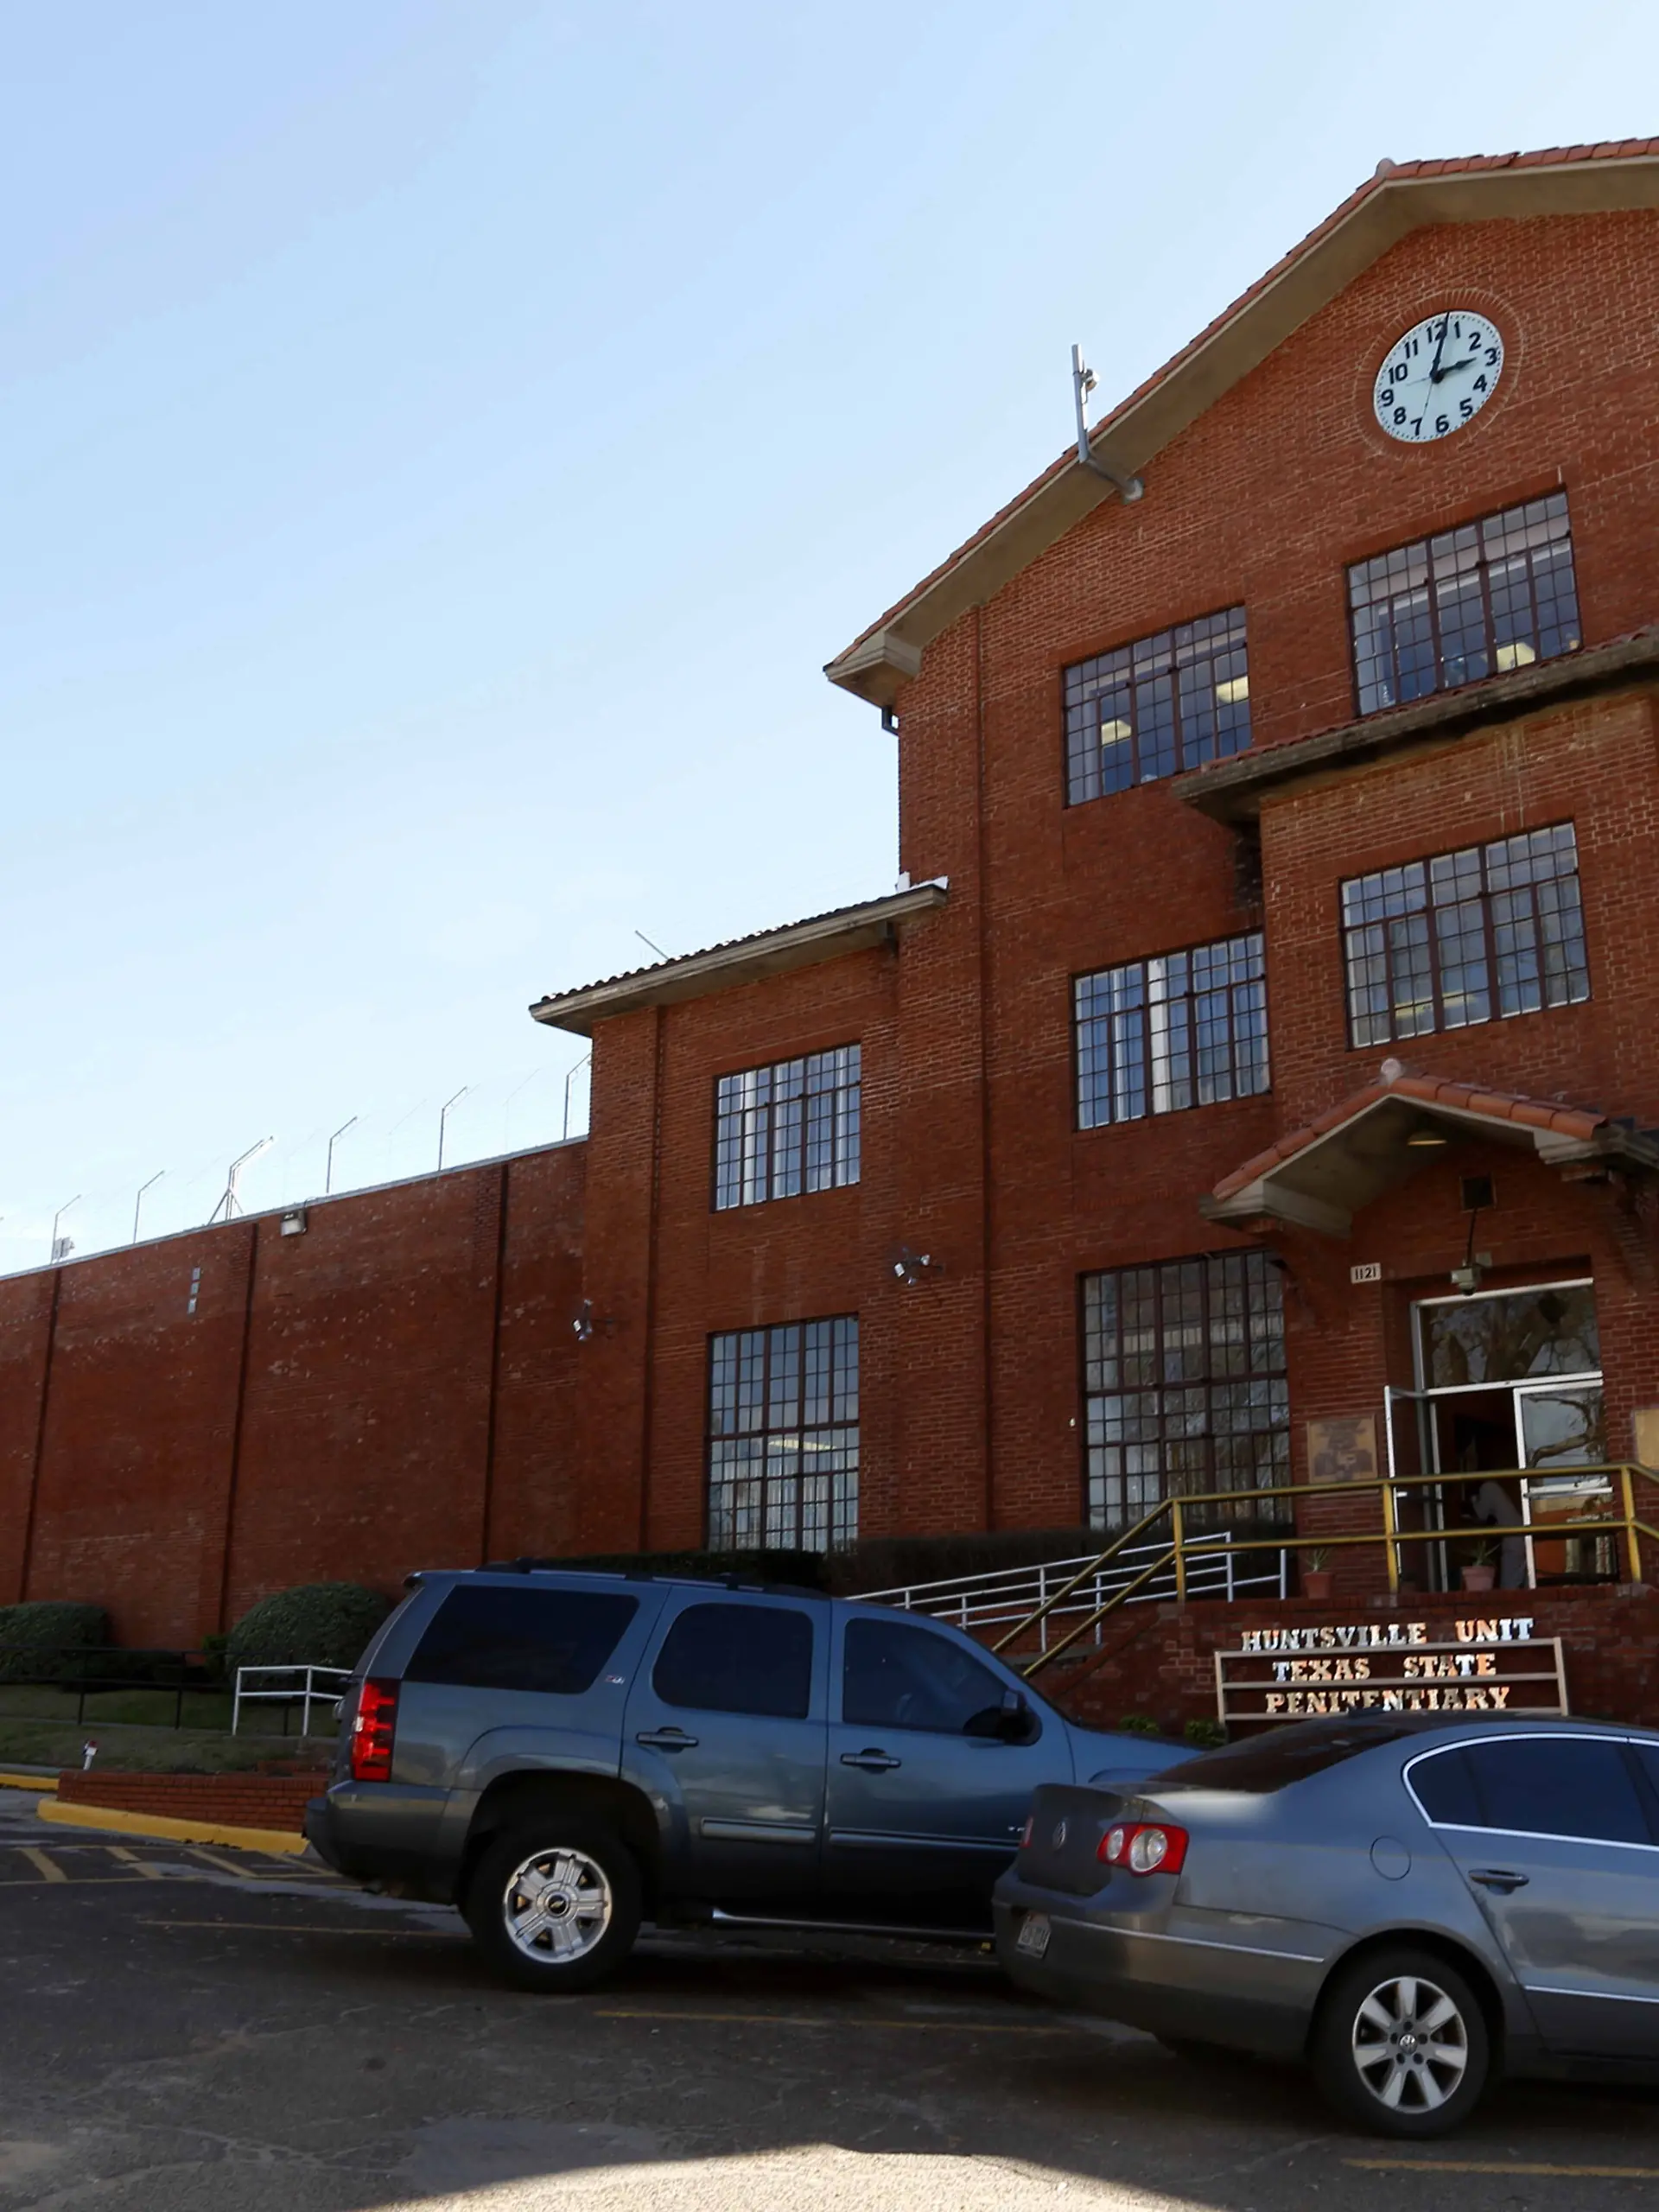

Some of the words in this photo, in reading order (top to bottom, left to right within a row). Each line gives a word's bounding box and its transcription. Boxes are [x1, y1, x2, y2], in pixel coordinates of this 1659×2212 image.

[1427, 321, 1447, 343] 12
[1453, 321, 1460, 339] 1
[1404, 340, 1418, 359] 11
[1468, 332, 1482, 352] 2
[1484, 347, 1497, 366] 3
[1389, 363, 1408, 385] 10
[1472, 374, 1487, 392] 4
[1381, 389, 1394, 407] 9
[1459, 397, 1473, 418] 5
[1393, 406, 1407, 425] 8
[1435, 415, 1449, 433] 6
[1410, 417, 1423, 435] 7
[1355, 1266, 1376, 1281] 1121
[1242, 1622, 1427, 1651] HUNTSVILLE
[1455, 1618, 1534, 1643] UNIT
[1273, 1657, 1371, 1682] TEXAS
[1403, 1653, 1497, 1678] STATE
[1265, 1686, 1510, 1714] PENITENTIARY
